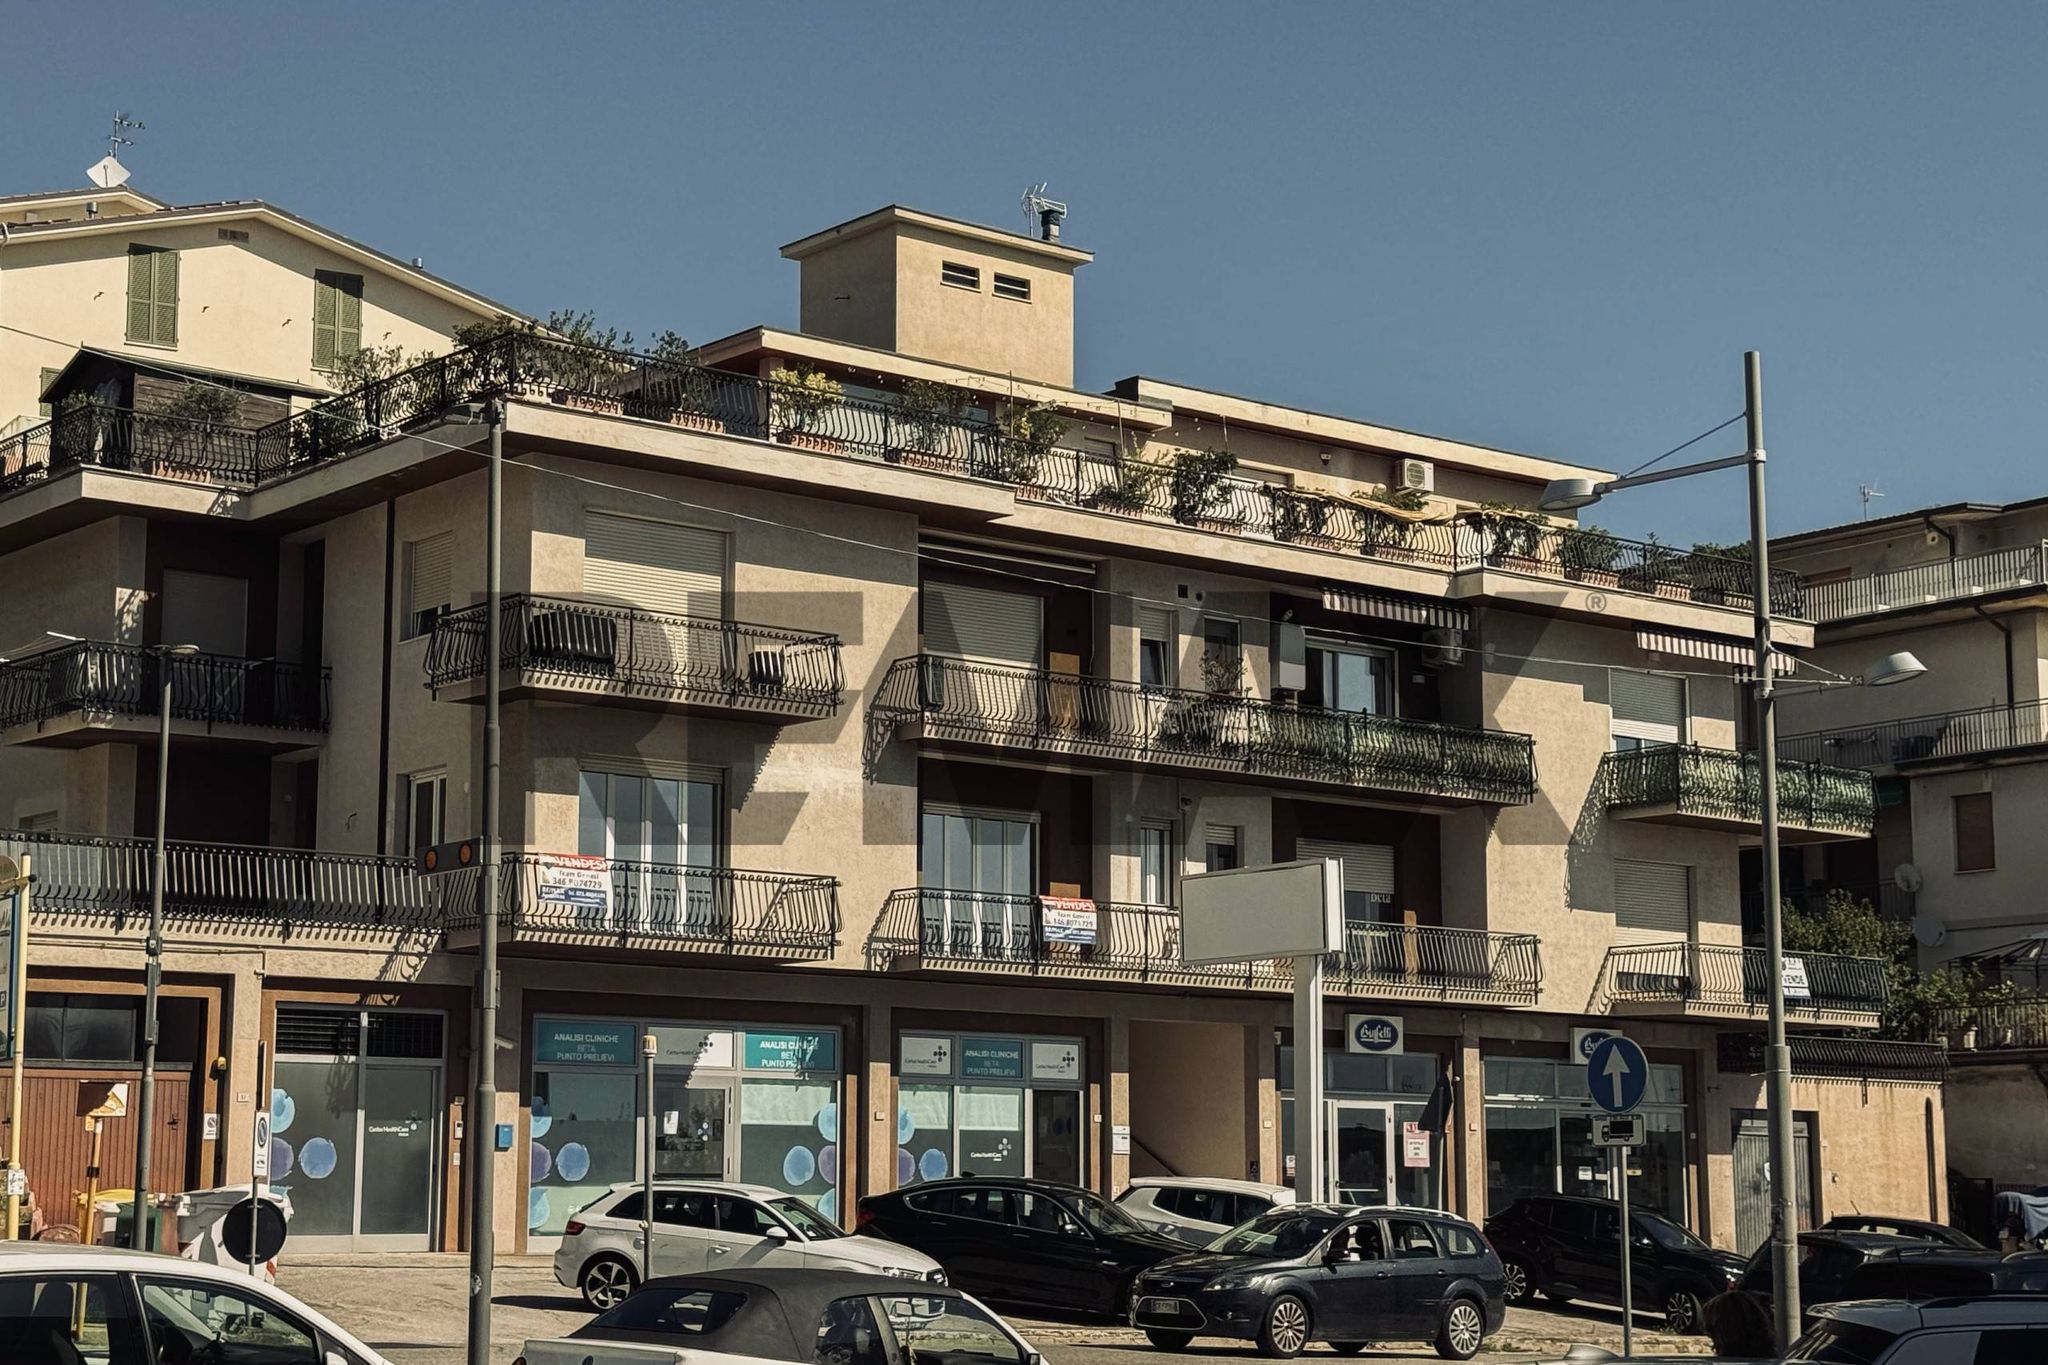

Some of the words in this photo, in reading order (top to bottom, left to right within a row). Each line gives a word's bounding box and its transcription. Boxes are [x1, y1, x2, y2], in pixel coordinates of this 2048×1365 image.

[552, 876, 566, 886] 346
[554, 1033, 584, 1042] ANALISI
[585, 1034, 619, 1043] CLINICHE
[577, 1044, 597, 1053] BETA
[759, 1040, 788, 1050] ANALISI
[556, 1052, 582, 1061] PUNTO
[583, 1053, 615, 1063] PRELIEVI
[964, 1049, 990, 1058] ANALISI
[990, 1050, 1019, 1060] CLINICHE
[761, 1059, 785, 1068] PUNTO
[966, 1066, 989, 1075] PUNTO
[989, 1067, 1016, 1077] PRELIEVI
